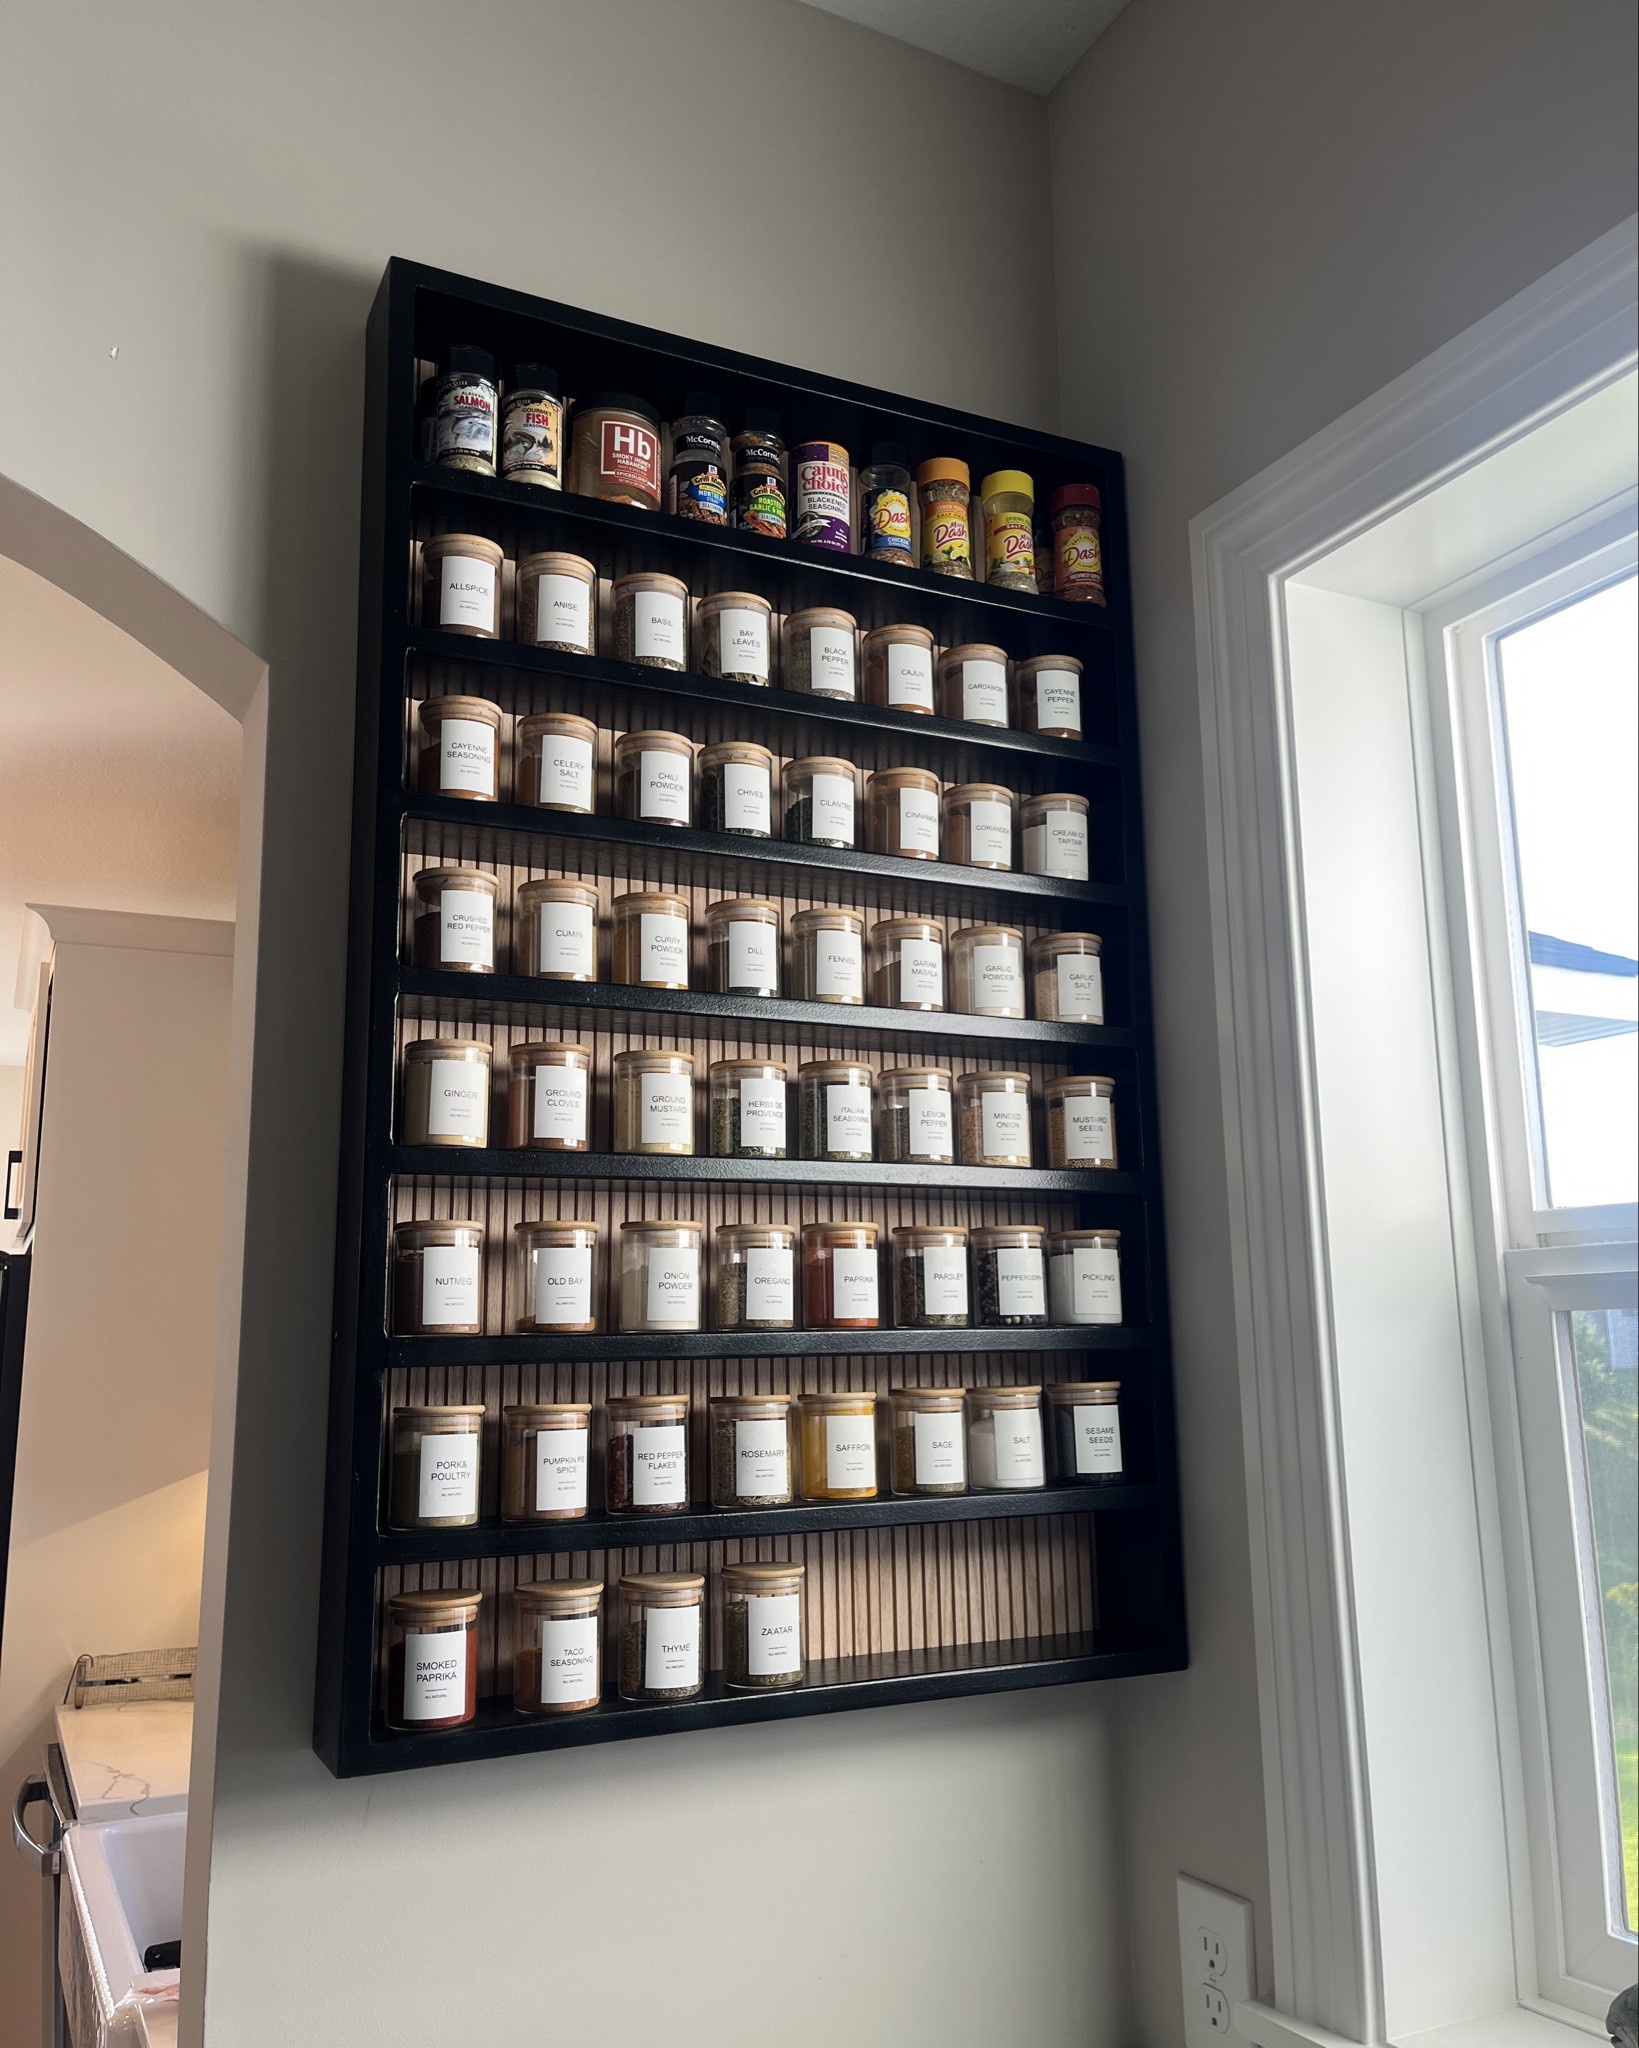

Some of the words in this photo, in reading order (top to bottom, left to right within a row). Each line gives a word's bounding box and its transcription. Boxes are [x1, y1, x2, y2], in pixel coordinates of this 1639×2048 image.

[461, 390, 485, 398] ALASKAN
[453, 395, 491, 412] SALMON
[521, 407, 552, 417] GOURMET
[525, 412, 549, 427] FISH
[522, 423, 551, 432] SEASONING
[614, 426, 651, 460] Hb
[612, 452, 634, 460] SMOKY
[634, 456, 651, 469] HONEY
[616, 458, 648, 472] HABANERO
[616, 471, 648, 483] SPICEOLOGY
[693, 475, 710, 484] Grill
[752, 487, 768, 496] Grill
[758, 496, 782, 509] ROASTED
[807, 496, 846, 509] BLACKENED
[749, 503, 771, 512] GARLIC
[808, 503, 845, 516] SEASONING
[933, 524, 967, 543] Dash
[887, 537, 909, 546] CHICKEN
[1063, 545, 1098, 569] Dash
[449, 583, 488, 596] ALLSPICE
[553, 601, 578, 611] ANISE
[651, 617, 673, 627] BASIL
[732, 639, 760, 648] LEAVES
[824, 647, 847, 657] BLACK
[821, 655, 849, 665] PEPPER
[901, 669, 925, 678] CAJUN
[1044, 689, 1076, 698] CAYENNE
[1047, 696, 1074, 704] PEPPER
[451, 742, 487, 753] CAYENNE
[446, 751, 491, 764] SEASONING
[554, 760, 584, 771] CELERY
[560, 770, 579, 778] SALT
[658, 773, 678, 782] CHILI
[650, 781, 684, 792] POWDER
[737, 789, 764, 799] CHIVES
[1052, 830, 1078, 838] CREAM
[1058, 837, 1082, 846] TARTAR
[453, 914, 487, 924] CRUSHED
[465, 923, 491, 933] PEPPER
[556, 930, 583, 938] CUMIN
[655, 936, 681, 944] CURRY
[651, 945, 683, 954] POWDER
[747, 947, 763, 955] DILL
[829, 955, 856, 965] FENNEL
[913, 960, 937, 969] GARAM
[912, 969, 938, 977] MASALA
[983, 974, 1014, 982] POWDER
[1069, 974, 1095, 982] GARLIC
[444, 1090, 478, 1099] GINGER
[546, 1089, 581, 1098] GROUND
[547, 1099, 580, 1109] CLOVES
[652, 1096, 685, 1104] GROUND
[650, 1105, 687, 1114] MUSTARD
[746, 1110, 784, 1118] PROVENCE
[923, 1111, 946, 1119] LEMON
[996, 1121, 1020, 1129] ONION
[664, 1272, 689, 1280] ONION
[435, 1278, 472, 1286] NUTMEG
[547, 1277, 566, 1285] OLD
[754, 1277, 790, 1285] OREGANO
[658, 1282, 693, 1290] POWDER
[1085, 1427, 1115, 1435] SESAME
[1013, 1436, 1031, 1444] SALT
[1089, 1436, 1114, 1444] SEEDS
[932, 1441, 953, 1449] SAGE
[638, 1453, 655, 1461] RED
[657, 1451, 684, 1460] PEPPER
[741, 1450, 784, 1458] ROSEMARY
[543, 1457, 577, 1465] PUMPKIN
[557, 1466, 577, 1474] SPICE
[648, 1462, 677, 1470] FLAKES
[431, 1472, 470, 1481] POULTRY
[563, 1648, 584, 1656] TACO
[662, 1643, 690, 1653] THYME
[416, 1660, 457, 1671] SMOKED
[550, 1656, 593, 1667] SEASONING
[416, 1671, 457, 1683] PAPRIKA
